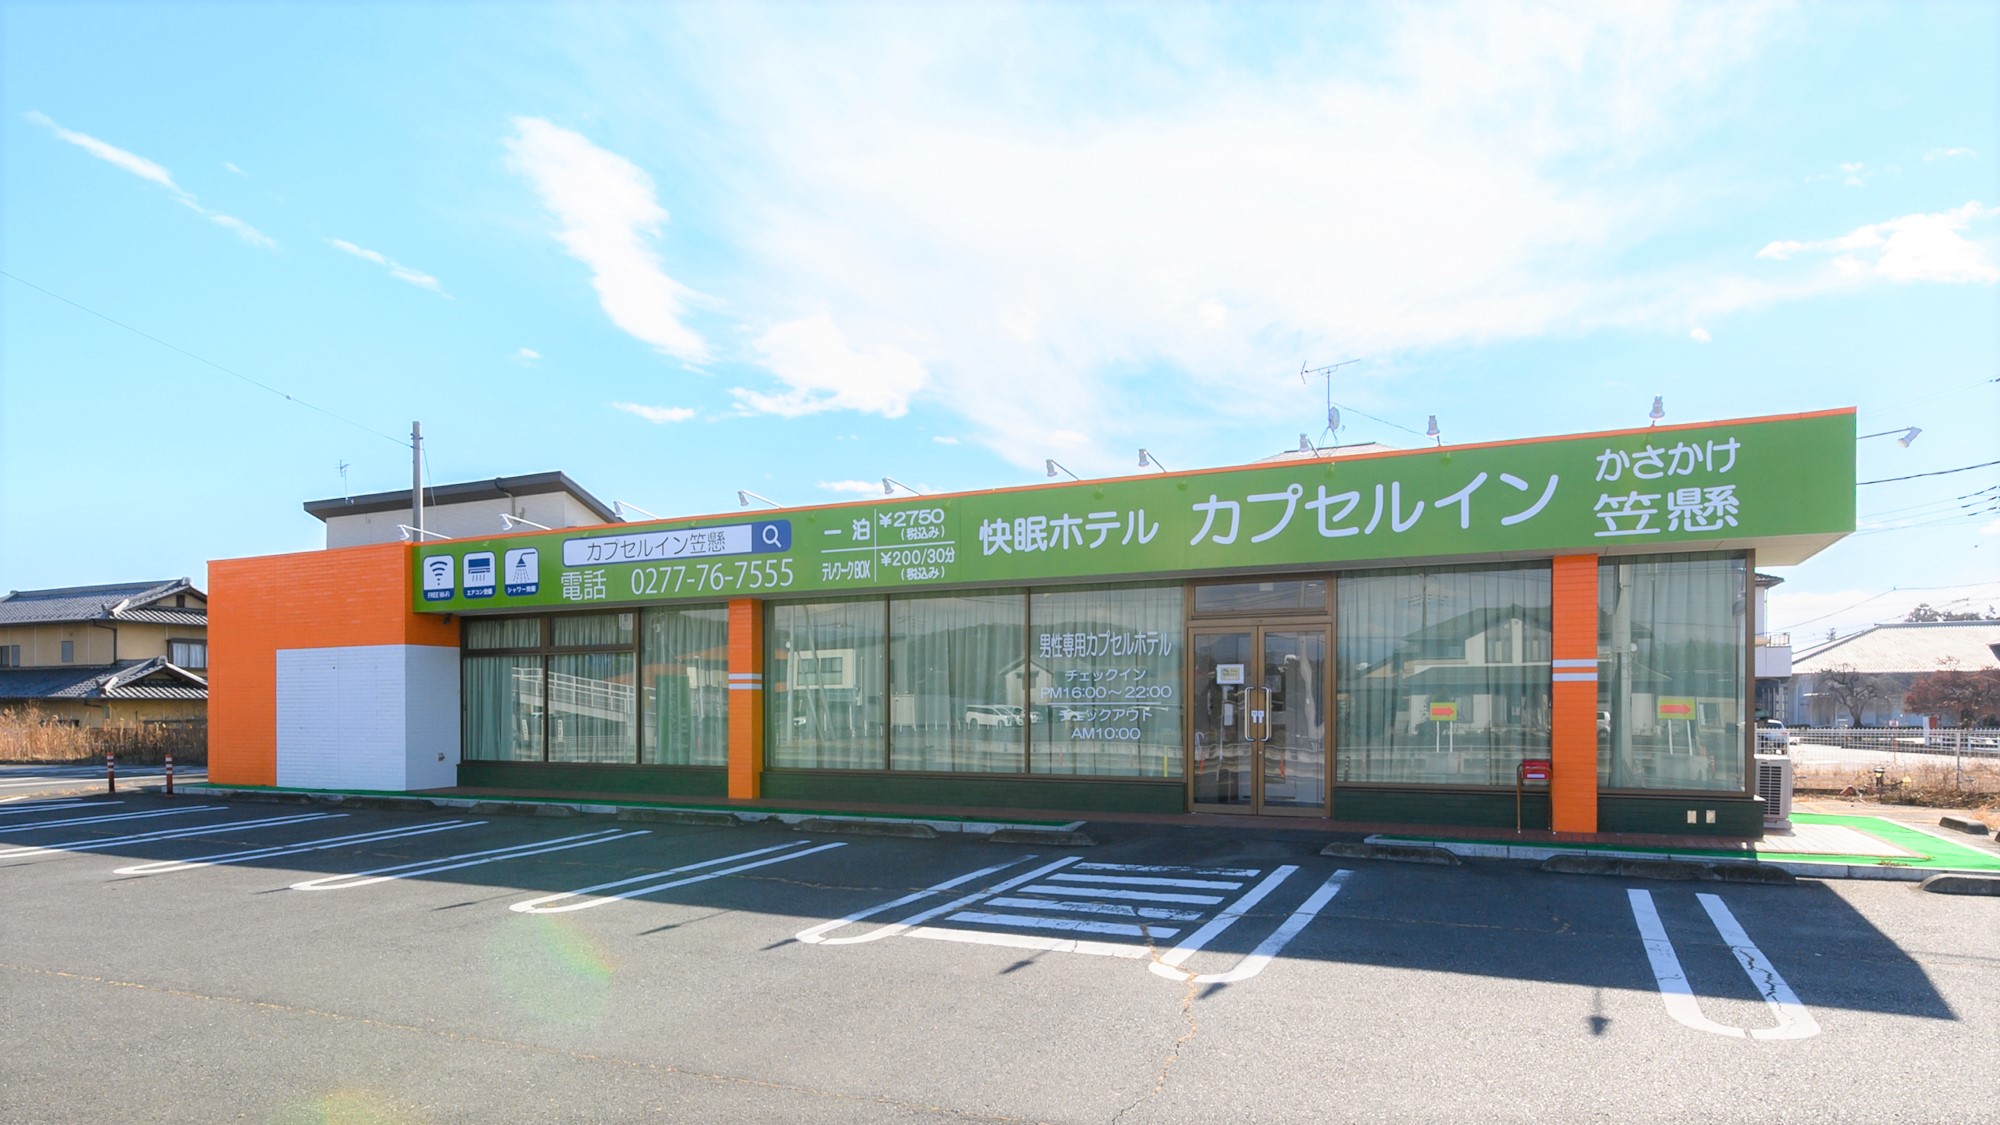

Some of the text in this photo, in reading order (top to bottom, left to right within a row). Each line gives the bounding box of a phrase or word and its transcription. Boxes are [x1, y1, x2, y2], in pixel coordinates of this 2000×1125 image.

[1595, 437, 1741, 481] かさかけ
[878, 508, 945, 528] ¥2750
[1190, 471, 1559, 546] カプセルイン
[1593, 484, 1740, 537] 笠懸
[586, 530, 726, 562] カプセルイン笠懸
[979, 509, 1159, 555] 快眠ホテル
[427, 591, 439, 599] FREE
[560, 558, 794, 600] 電話 0277-76-7555
[1039, 630, 1172, 658] 男性専用カプセルホテル
[1065, 668, 1146, 682] チェックイン
[1071, 727, 1141, 740] AM10:00
